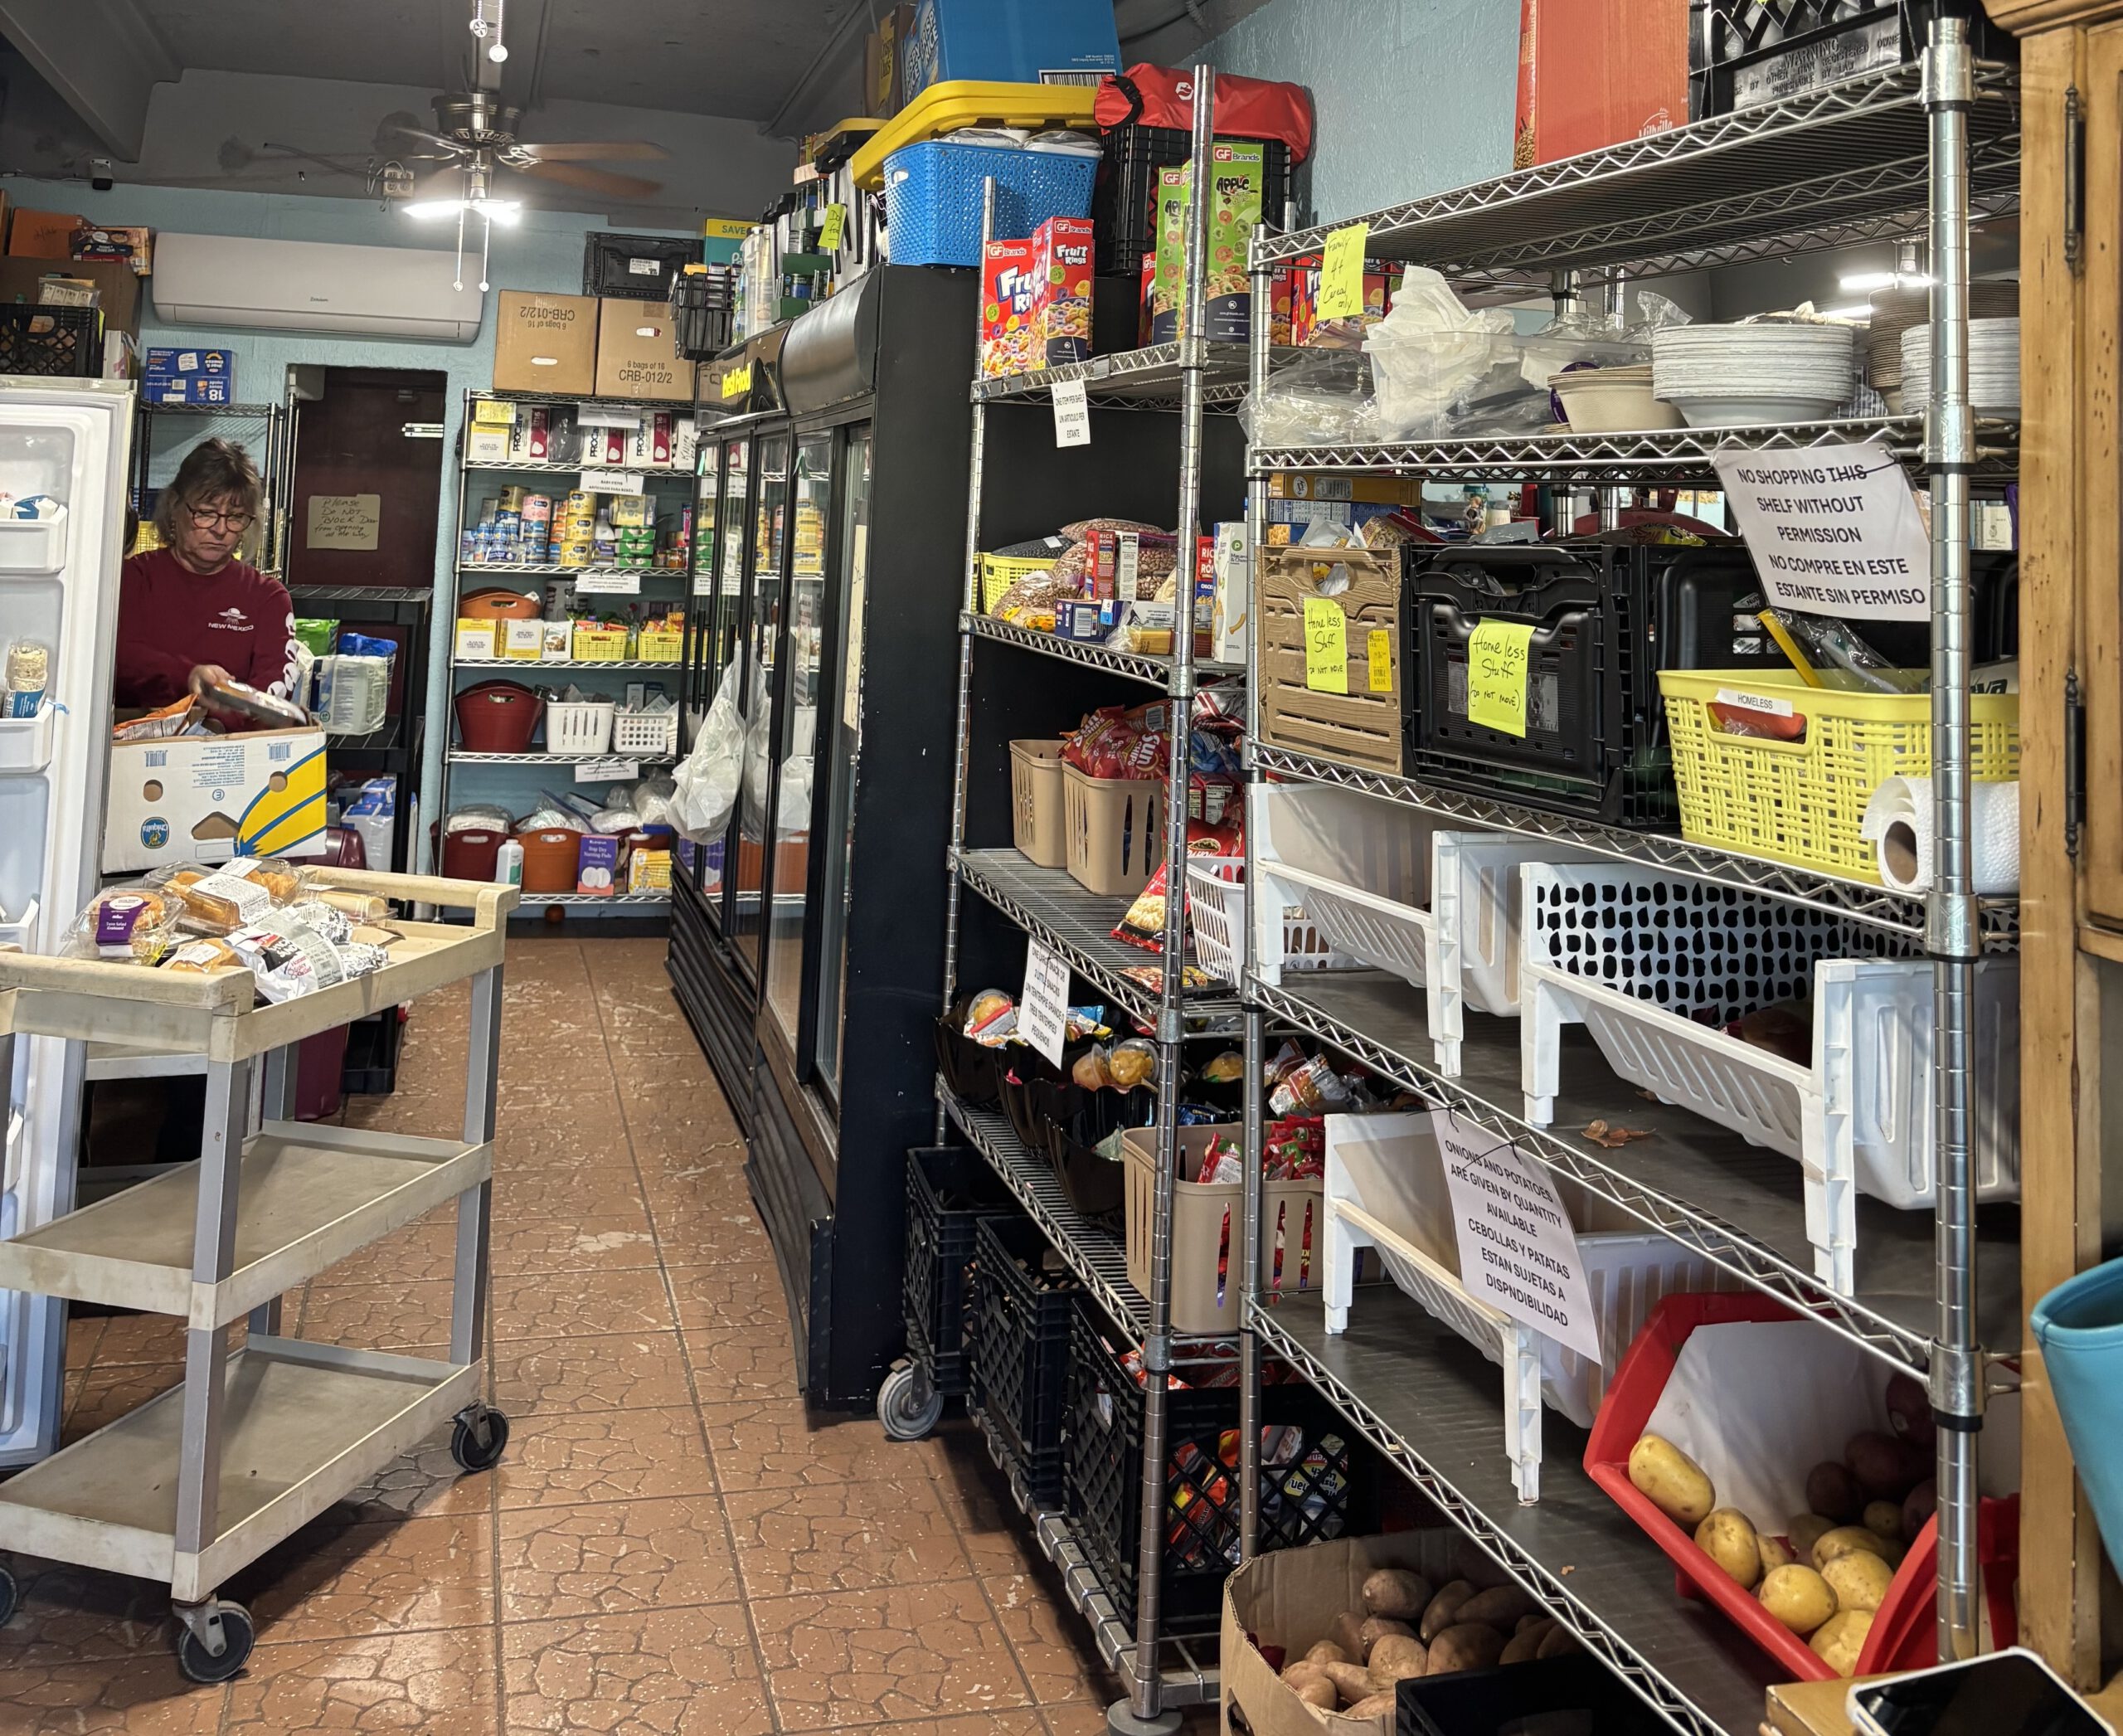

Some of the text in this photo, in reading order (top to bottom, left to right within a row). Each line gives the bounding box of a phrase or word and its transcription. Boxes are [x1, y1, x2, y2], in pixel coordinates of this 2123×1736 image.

[1877, 34, 1900, 48] OWNE
[1784, 38, 1840, 70] WARNING
[1215, 148, 1231, 160] GF
[1164, 174, 1180, 184] GF
[721, 225, 746, 234] SAVE
[1056, 222, 1069, 232] GF
[990, 246, 1003, 257] GF
[1057, 245, 1089, 258] Fruit
[1328, 233, 1352, 256] Family
[731, 252, 743, 265] Pa
[1066, 257, 1087, 265] Rings
[1000, 266, 1032, 299] Fru
[1324, 281, 1347, 304] Cereal
[1014, 294, 1032, 313] Ri
[1338, 295, 1353, 314] only
[520, 306, 575, 321] CRB-012/2
[546, 322, 561, 330] bags
[633, 361, 649, 370] bags
[650, 361, 656, 369] of
[619, 370, 673, 384] CRB-012/2
[209, 390, 225, 401] 18
[513, 413, 523, 452] PROCare
[636, 419, 646, 457] PROCare
[590, 427, 599, 458] PROCa
[1737, 464, 1868, 485] NO SHOPPING THIS
[1756, 496, 1864, 514] SHELF WITHOUT
[1777, 526, 1862, 543] PERMISSION
[1202, 548, 1214, 558] RIC
[1768, 554, 1910, 576] NO COMPRE EN ESTE
[1776, 582, 1926, 605] ESTANTE SIN PERMISO
[1482, 659, 1515, 679] Stuff
[1484, 690, 1496, 699] NOT
[1737, 693, 1774, 710] HOMELESS
[1084, 717, 1105, 737] CHIPS
[1128, 742, 1142, 766] CHIPS
[1136, 734, 1160, 765] Sun
[1445, 1139, 1553, 1203] ONIONS AND POTATOES
[1450, 1164, 1562, 1229] ARE GIVEN BY QUANTITY
[1487, 1201, 1538, 1238] AVAILABLE
[1468, 1218, 1571, 1280] CEBOLLAS Y PATATAS
[1481, 1247, 1567, 1301] ESTAN SUJETAS A
[1486, 1272, 1568, 1327] DISPNDIBILIDAD
